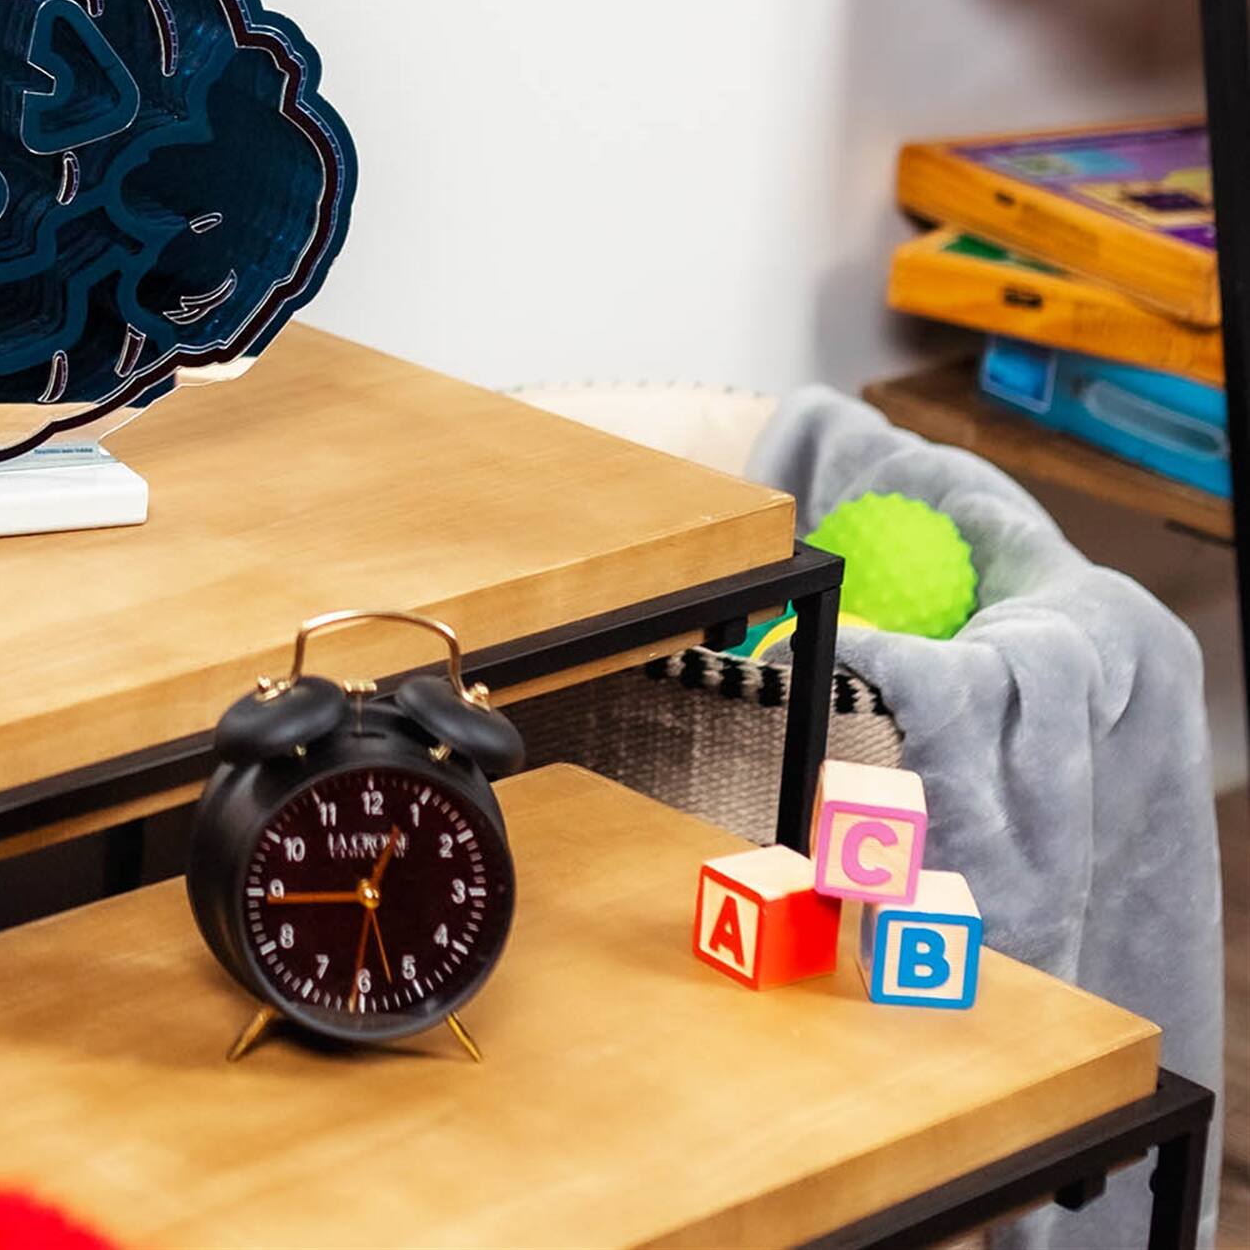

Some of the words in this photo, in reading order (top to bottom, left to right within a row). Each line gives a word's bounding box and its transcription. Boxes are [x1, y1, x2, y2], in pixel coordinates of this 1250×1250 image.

[318, 802, 337, 827] 11
[361, 791, 384, 816] 12
[410, 802, 419, 827] 1
[283, 836, 306, 862] 10
[439, 833, 453, 859] 2
[841, 821, 899, 886] C
[451, 878, 466, 904] 3
[280, 923, 294, 948] 8
[433, 923, 449, 948] 4
[707, 896, 745, 967] A
[315, 954, 330, 979] 7
[401, 954, 416, 980] 5
[896, 926, 951, 989] B
[357, 968, 371, 993] 6
